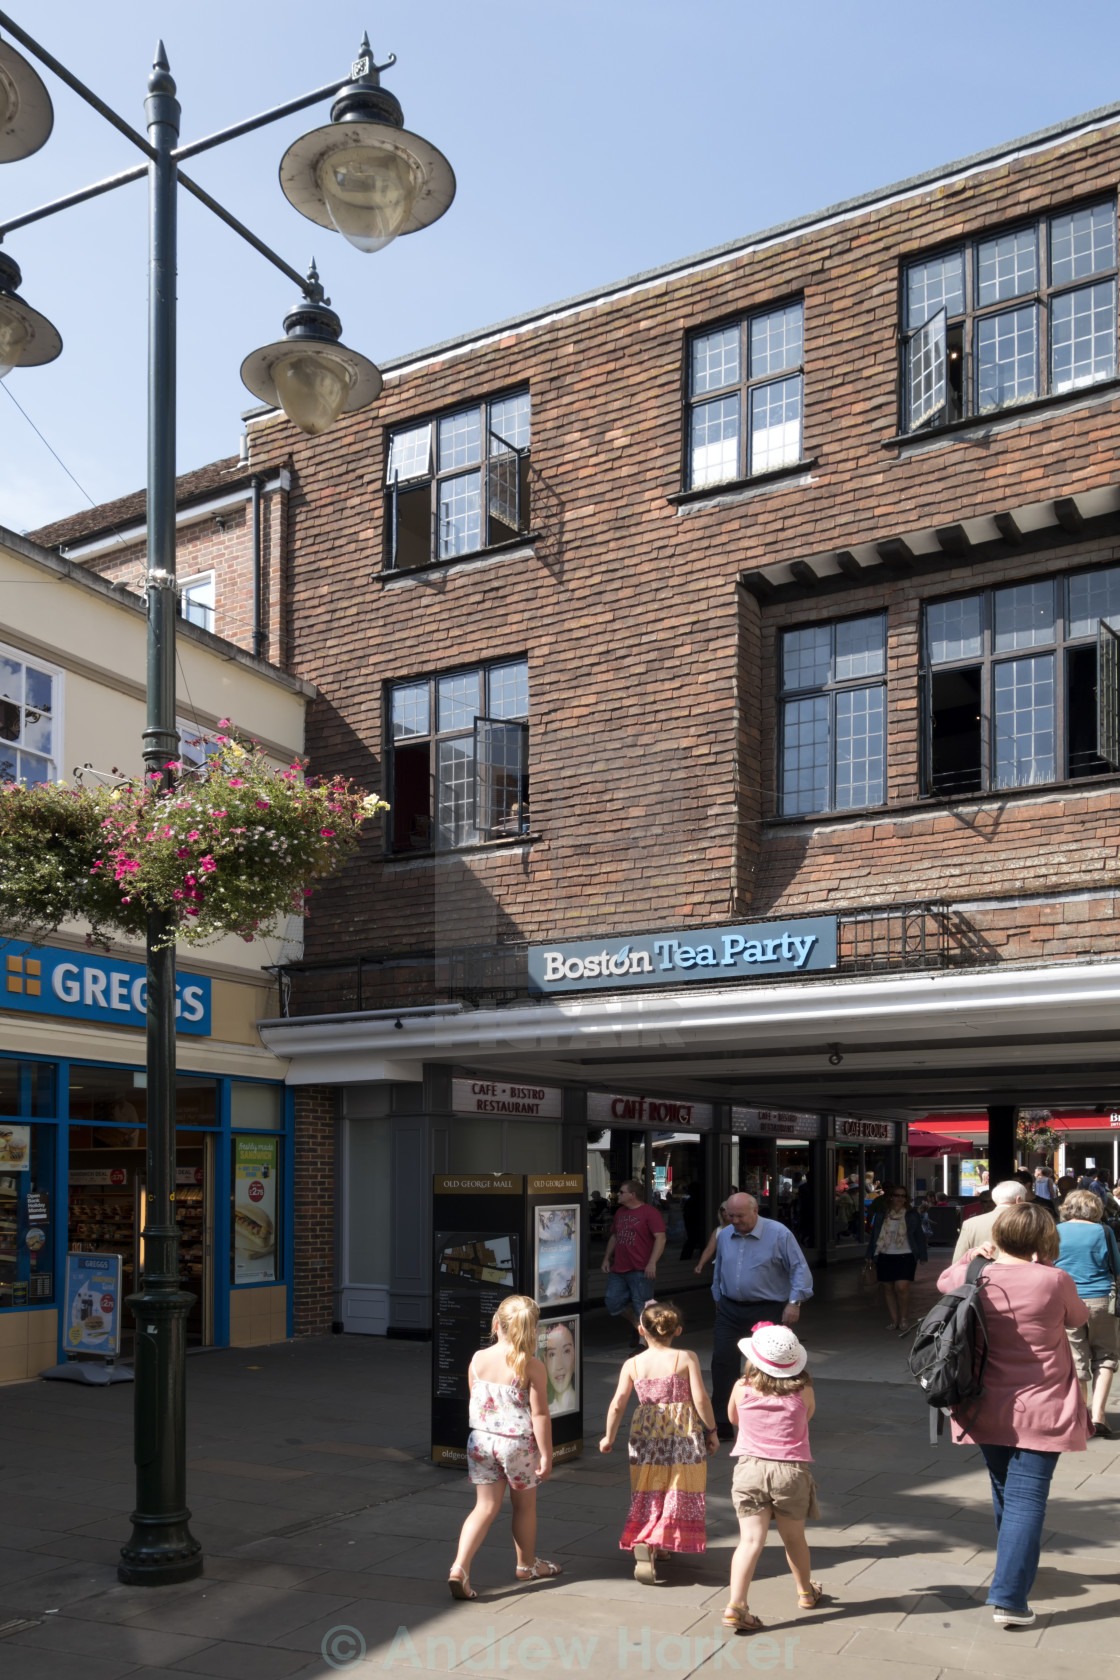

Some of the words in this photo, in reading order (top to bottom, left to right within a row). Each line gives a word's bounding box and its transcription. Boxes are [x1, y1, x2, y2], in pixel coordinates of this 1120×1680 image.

[543, 949, 654, 982] Boston
[653, 938, 718, 970] Tea
[720, 930, 817, 968] Party
[51, 961, 205, 1022] GREGS
[471, 1082, 498, 1097] CAFÉ
[510, 1086, 545, 1101] BISTRO
[476, 1099, 541, 1115] RESTAURANT
[611, 1095, 648, 1121] CAFÉ
[443, 1180, 460, 1188] OLD
[460, 1180, 491, 1189] GEORGE
[492, 1180, 513, 1188] MALL
[533, 1180, 545, 1189] OLD
[545, 1179, 565, 1189] GEORGE
[565, 1178, 579, 1188] MALL
[84, 1259, 109, 1270] GREGGS
